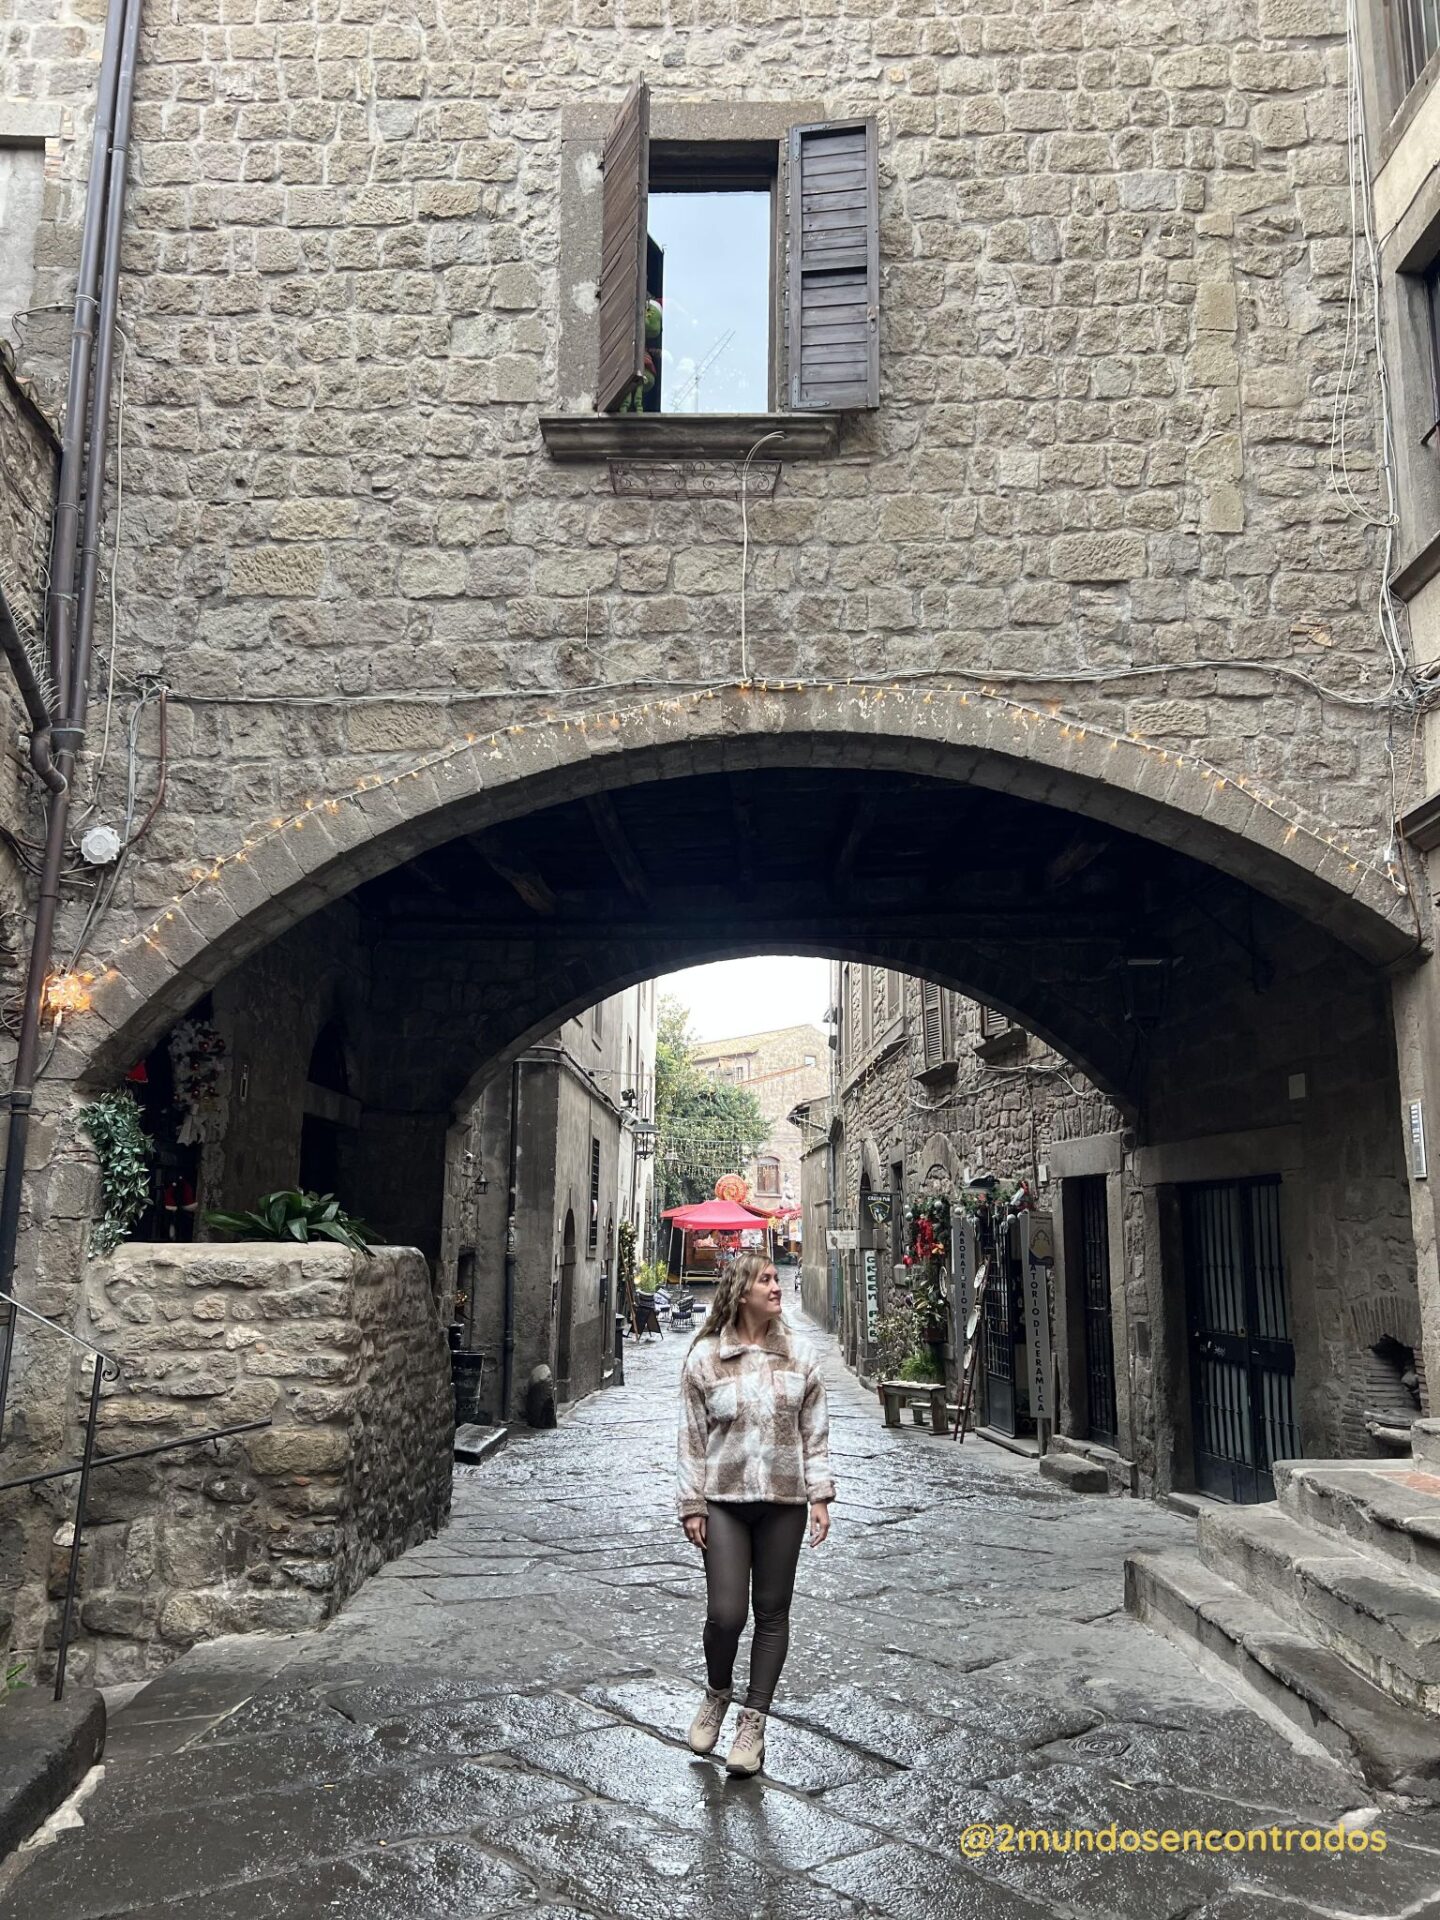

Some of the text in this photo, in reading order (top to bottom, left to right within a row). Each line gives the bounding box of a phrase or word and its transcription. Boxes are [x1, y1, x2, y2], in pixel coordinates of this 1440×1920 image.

[1029, 1263, 1044, 1412] ATORIO DI CERAMICA
